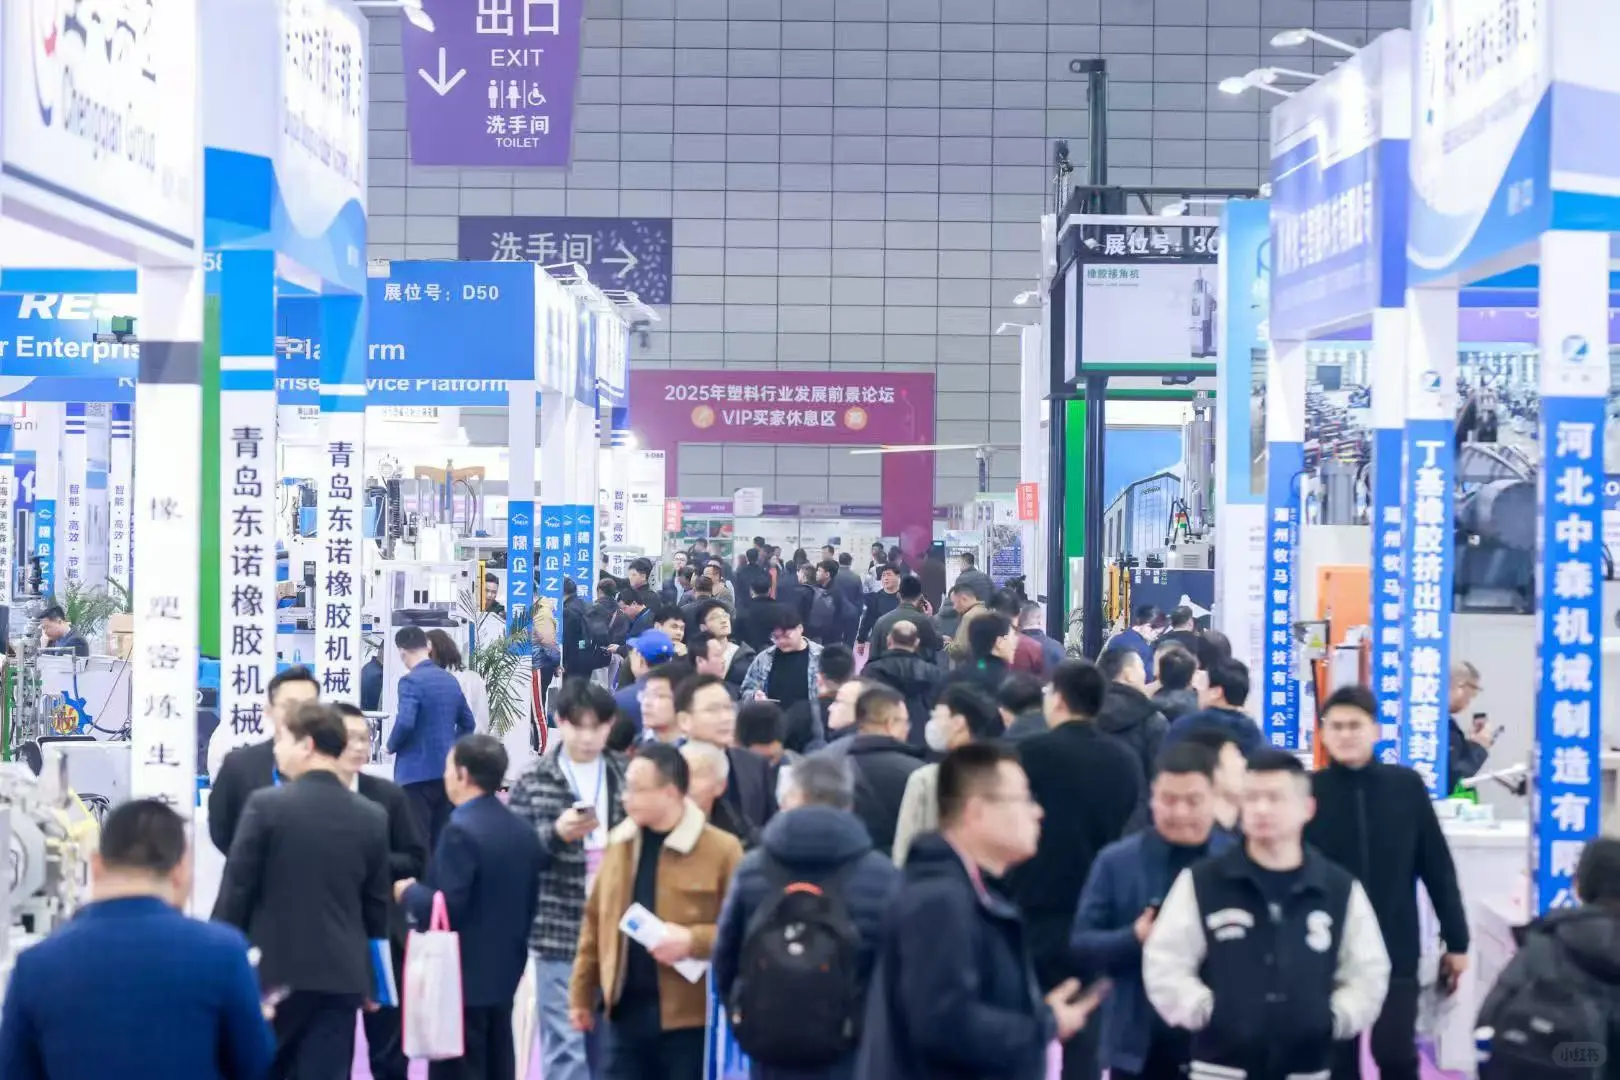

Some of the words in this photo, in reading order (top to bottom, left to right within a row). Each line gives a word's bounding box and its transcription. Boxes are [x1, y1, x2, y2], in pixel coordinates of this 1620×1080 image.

[476, 0, 559, 35] 出口
[491, 49, 544, 66] EXIT
[486, 116, 549, 134] 洗手间
[496, 137, 540, 148] TOILET
[491, 232, 593, 265] 洗手间
[463, 286, 499, 301] D50
[664, 384, 896, 404] 2025年塑料行业发展前景论坛
[722, 409, 837, 428] VIP买家休息区
[322, 441, 354, 703] 青岛东诺橡胶机械
[228, 426, 265, 749] 青岛东诺橡胶机械
